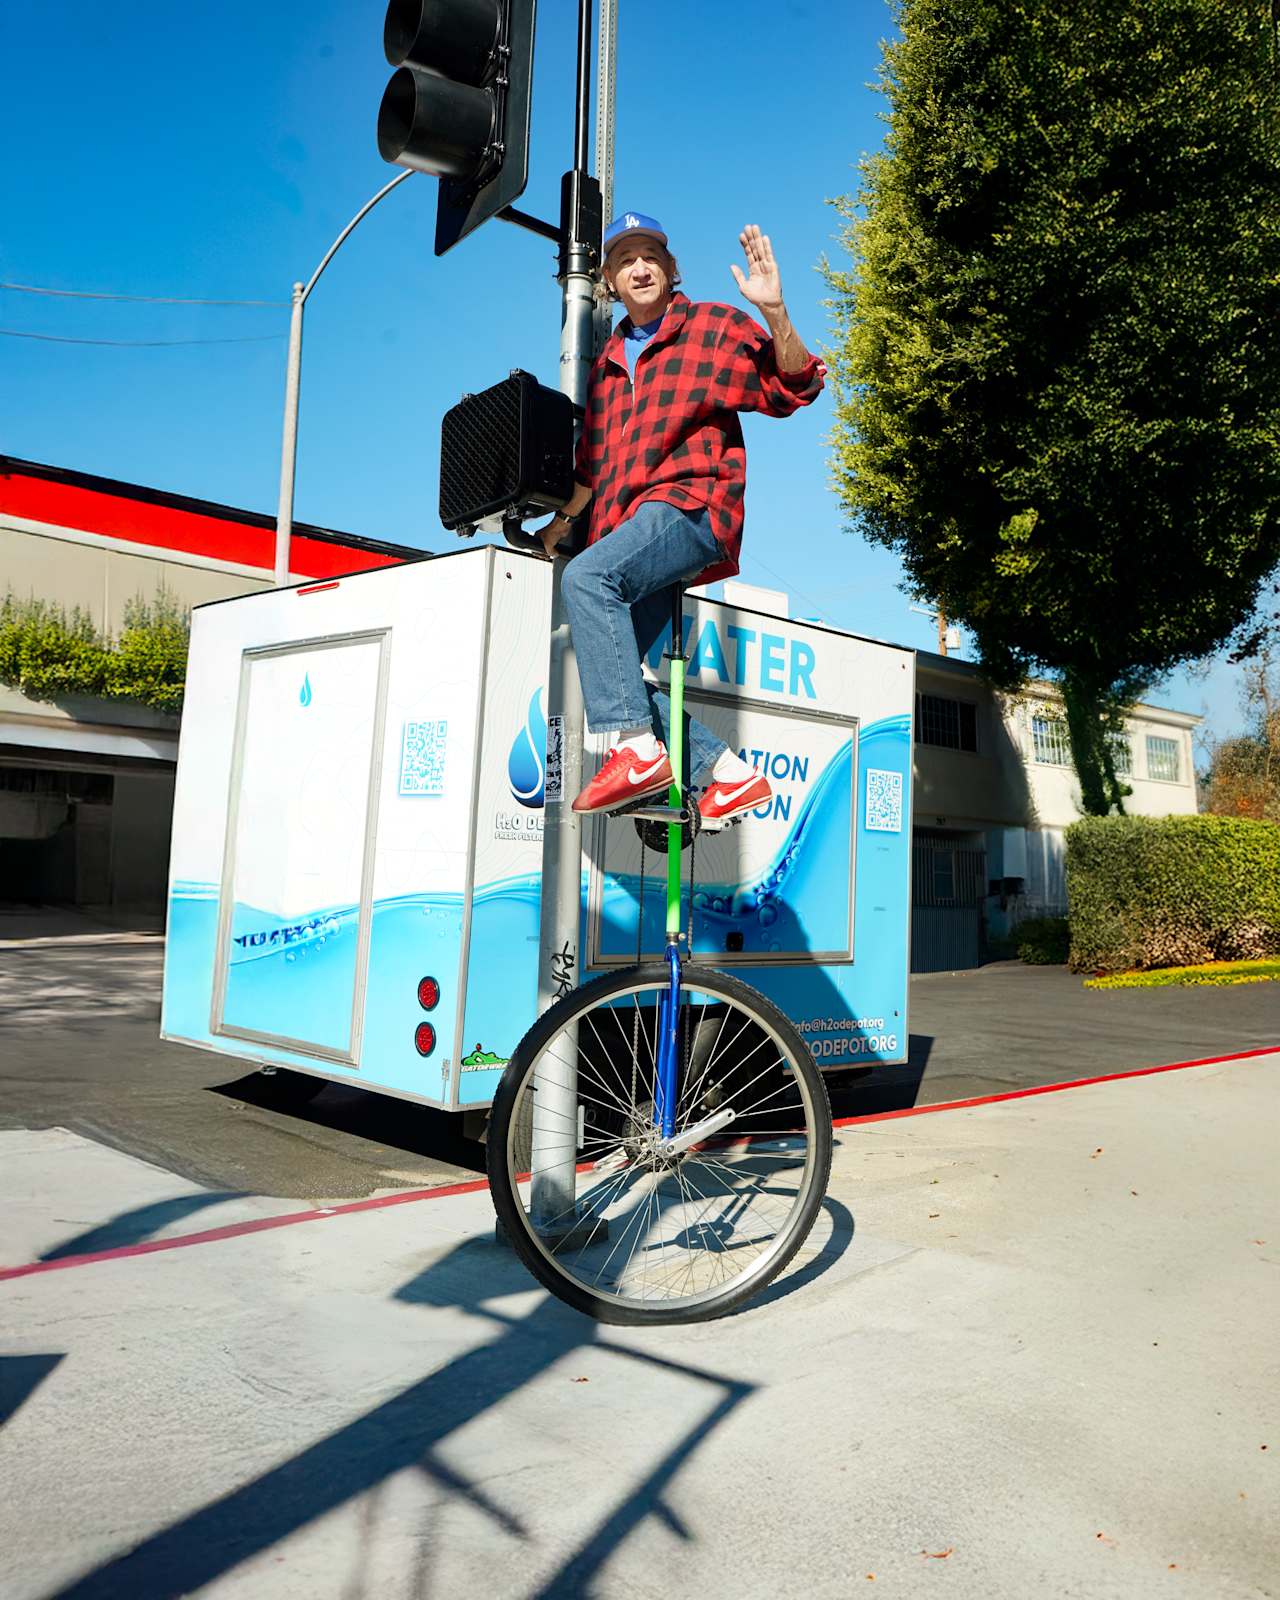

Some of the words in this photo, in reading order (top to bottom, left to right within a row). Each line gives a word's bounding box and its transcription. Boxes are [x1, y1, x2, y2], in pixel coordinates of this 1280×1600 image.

[625, 214, 640, 229] LA
[743, 794, 792, 822] ON
[792, 1017, 885, 1033] nfo@h2odepot.org
[804, 1034, 898, 1058] ODEPOT.ORG
